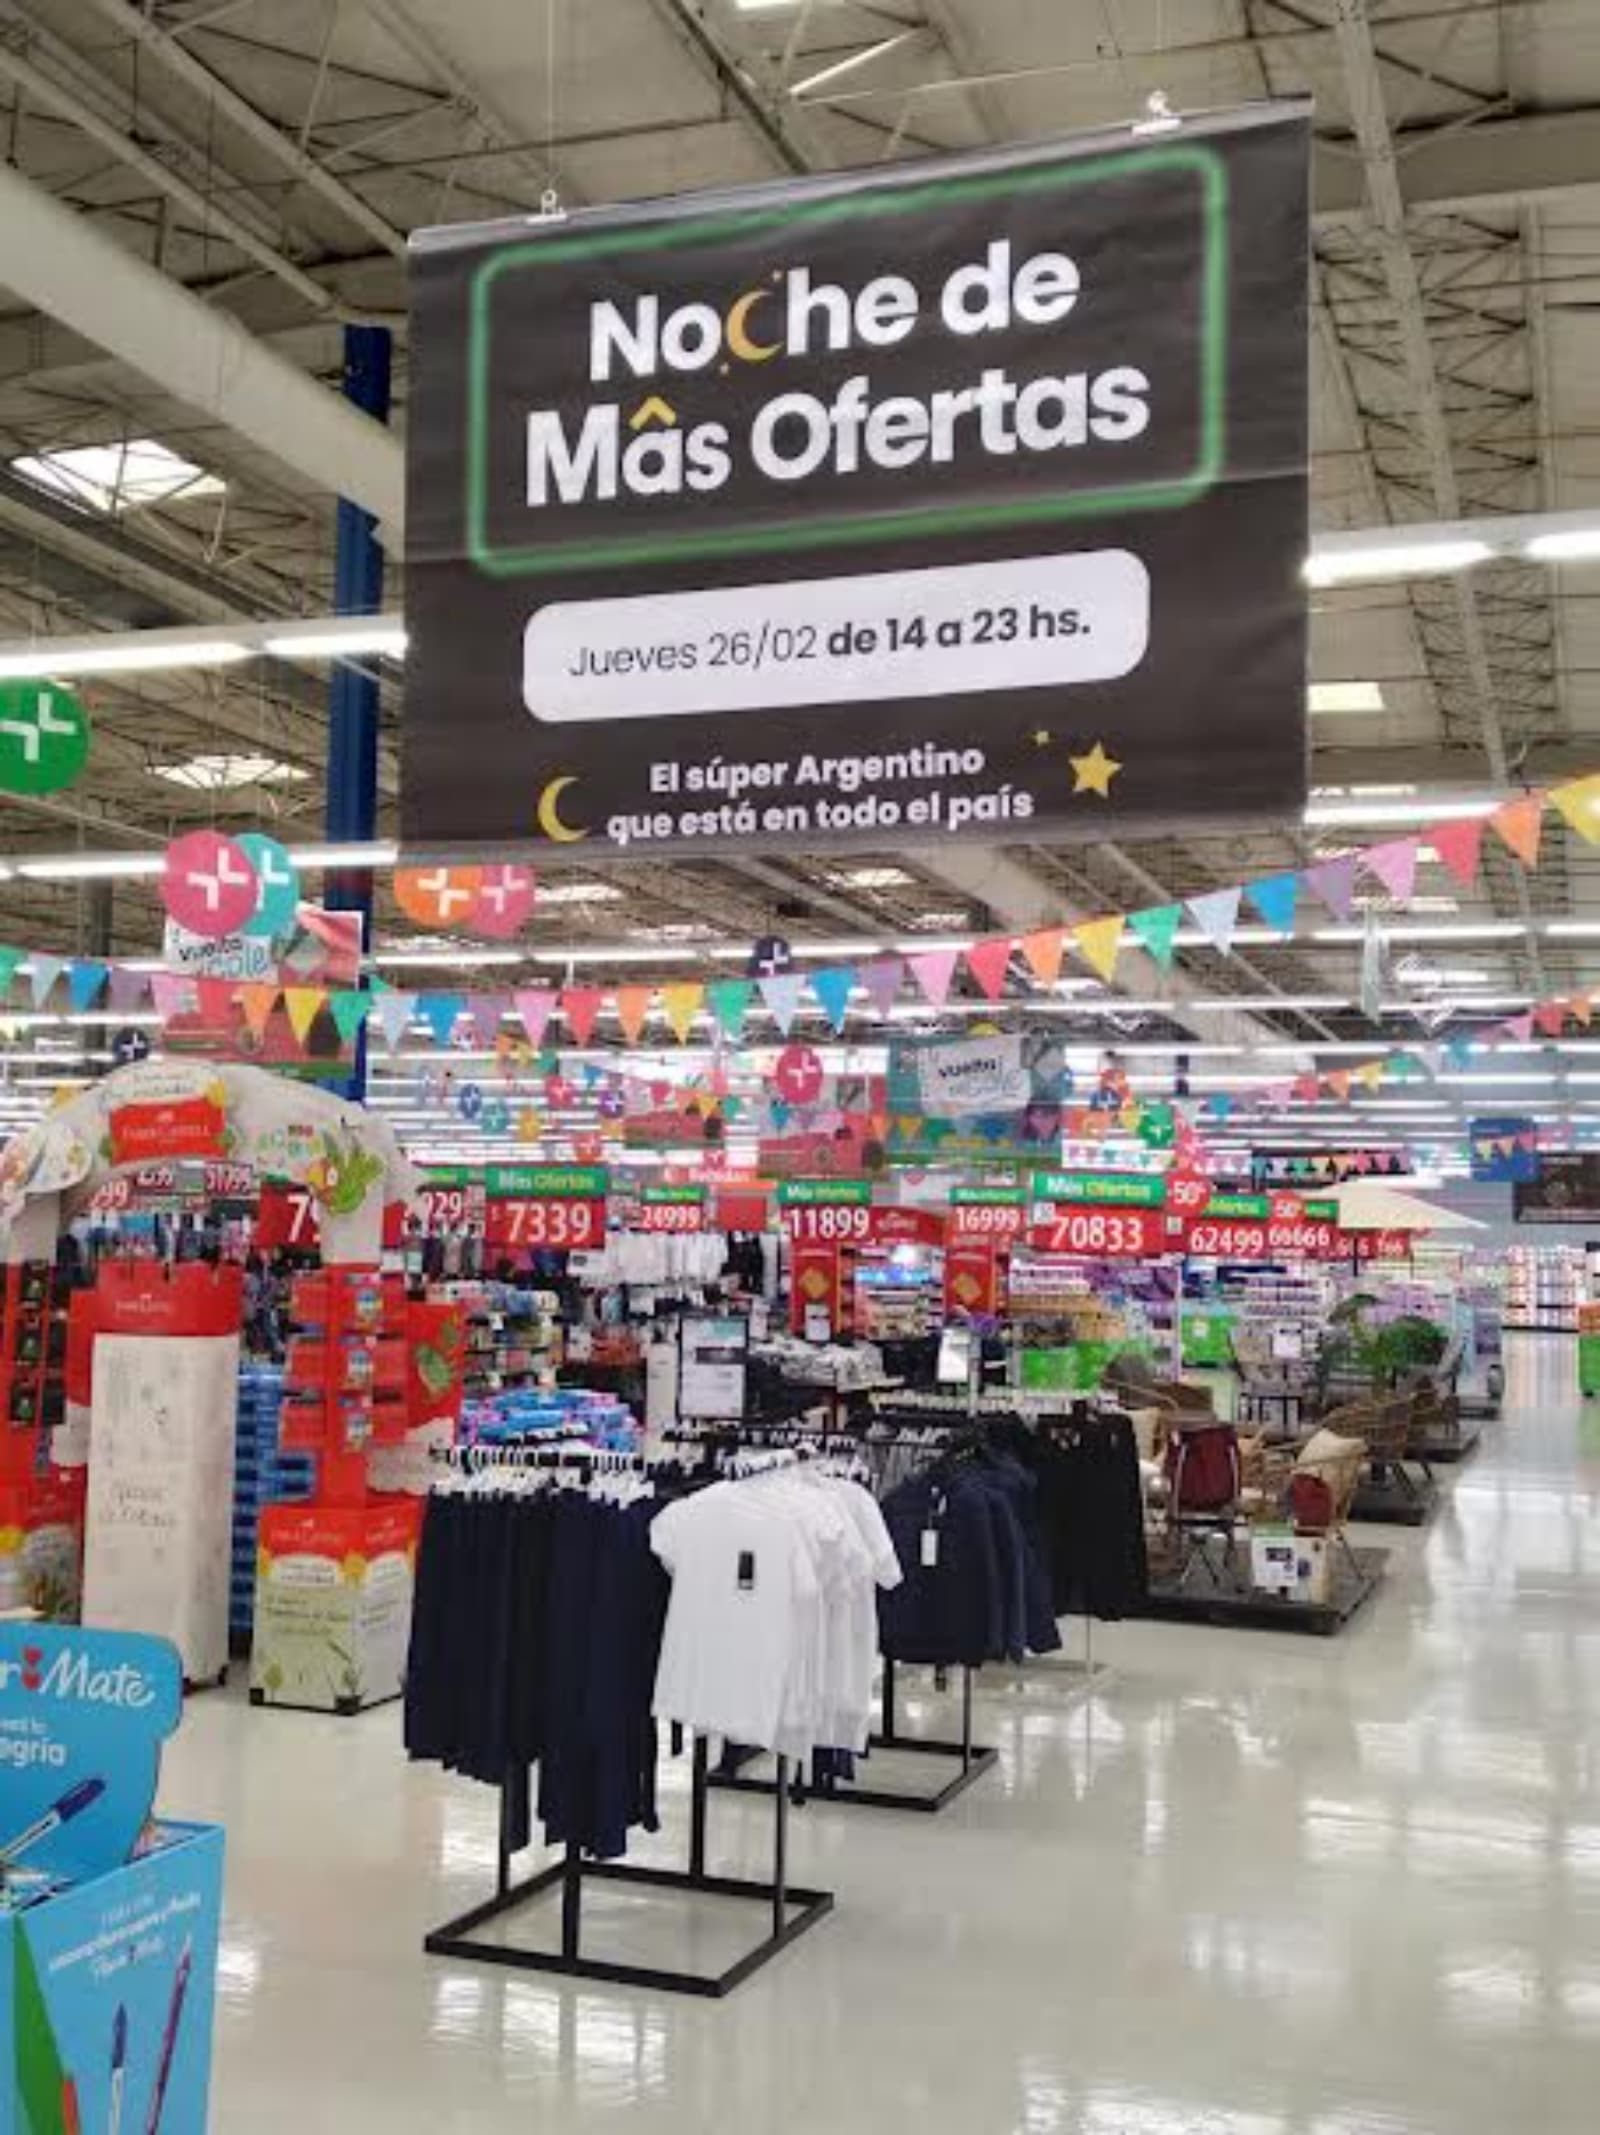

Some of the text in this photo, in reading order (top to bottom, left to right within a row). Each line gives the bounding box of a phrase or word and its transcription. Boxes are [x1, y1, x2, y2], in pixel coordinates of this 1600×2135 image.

[590, 239, 1081, 381] Noche de
[750, 366, 1150, 480] Ofertas
[568, 604, 1091, 677] Jueves 26/02 de 14 a 23 hs.
[650, 742, 985, 799] El súper Argentino
[607, 784, 1034, 846] que está en todo el país
[506, 1202, 592, 1242] 7339
[788, 1207, 870, 1240] 11899
[955, 1206, 1020, 1232] 16999
[1050, 1215, 1144, 1252] 70833
[1190, 1226, 1265, 1253] 62499
[38, 1647, 156, 1707] Mate
